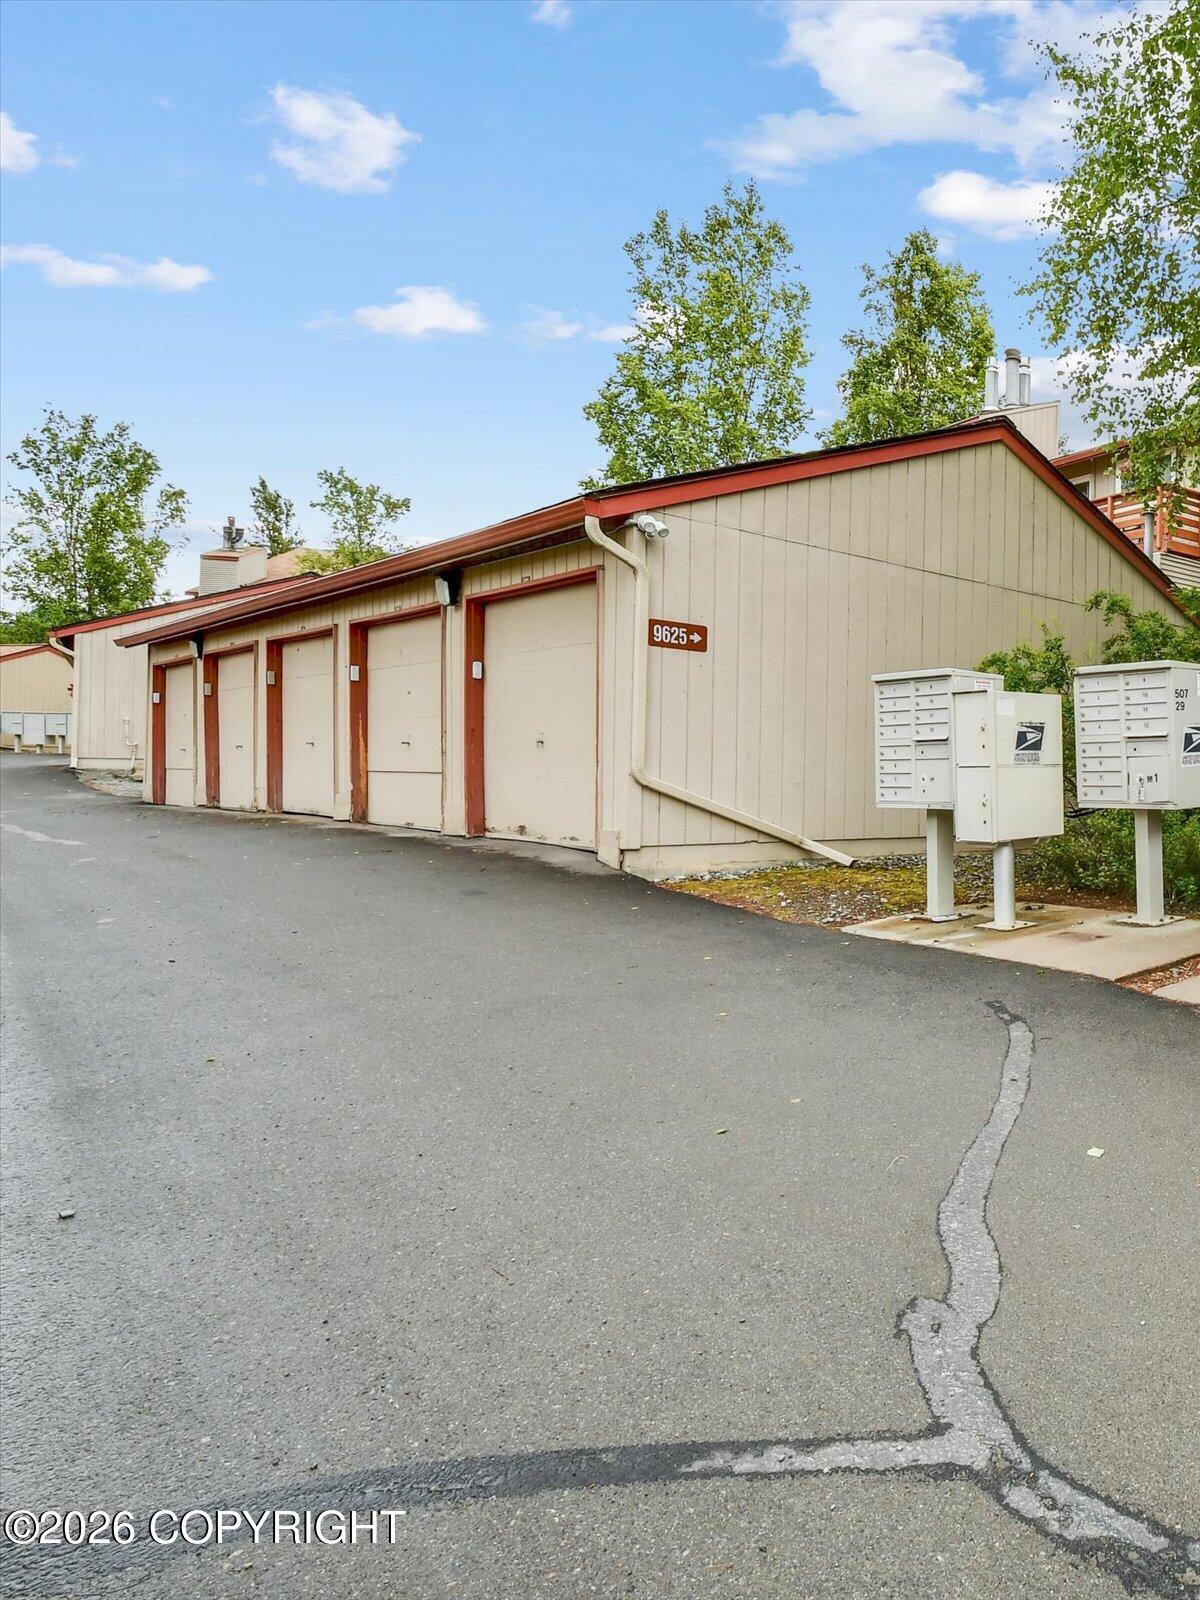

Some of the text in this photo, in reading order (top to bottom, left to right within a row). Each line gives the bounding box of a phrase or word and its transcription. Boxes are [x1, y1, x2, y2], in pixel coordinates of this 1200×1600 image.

[653, 624, 687, 645] 9625
[1174, 688, 1189, 699] 507
[1175, 701, 1186, 711] 29
